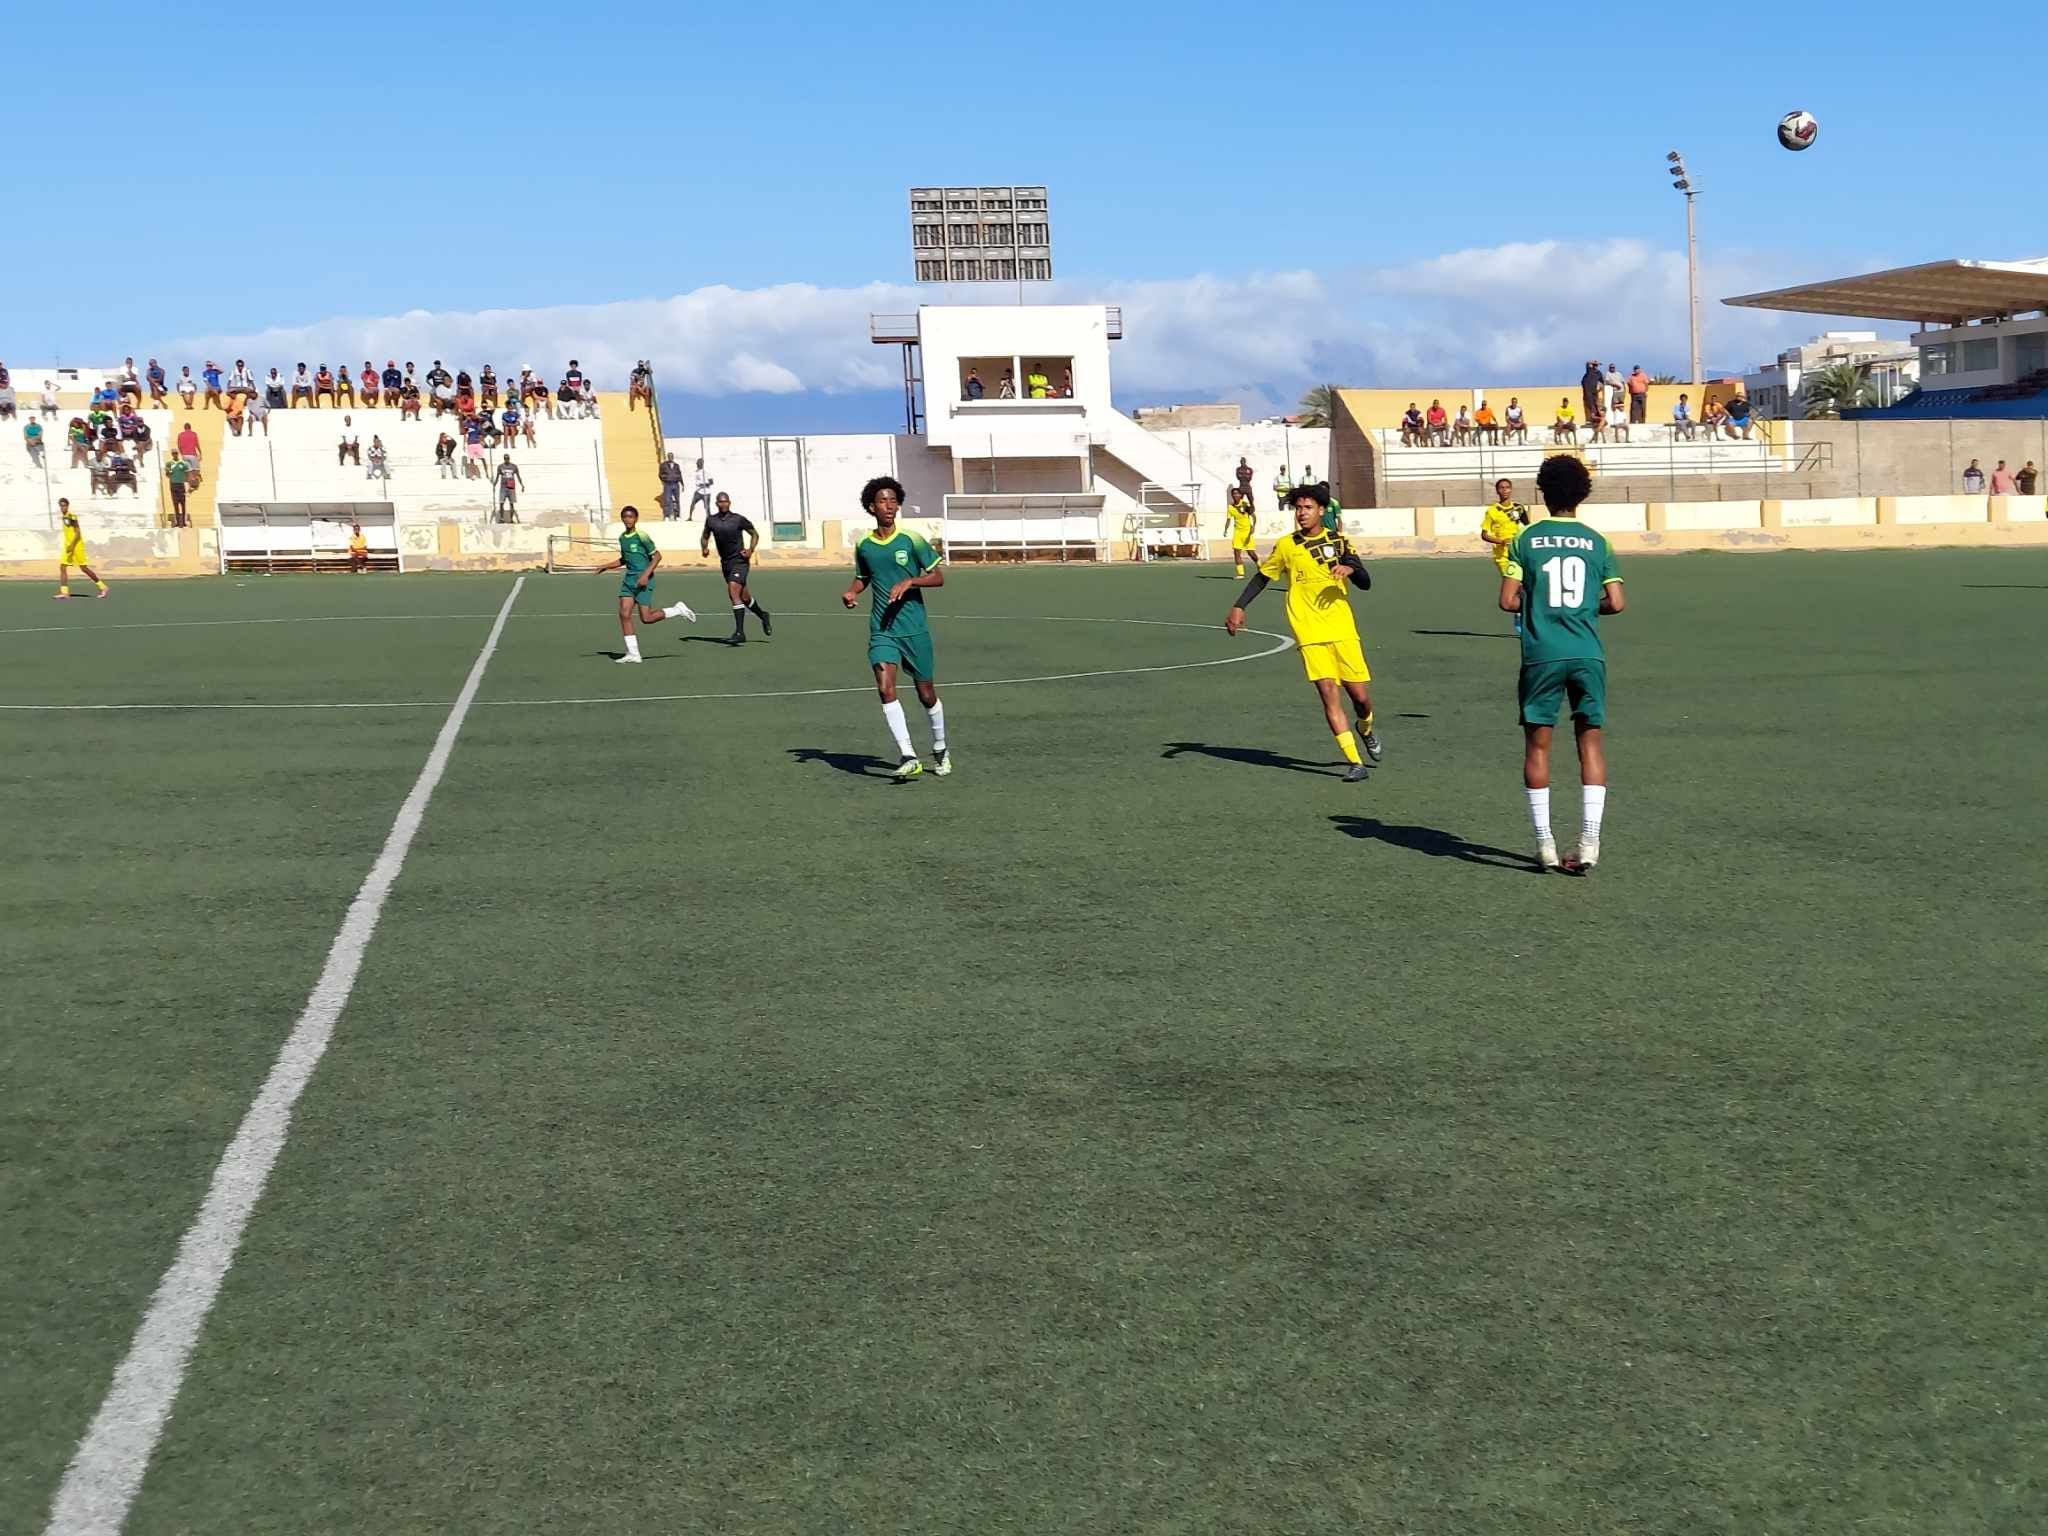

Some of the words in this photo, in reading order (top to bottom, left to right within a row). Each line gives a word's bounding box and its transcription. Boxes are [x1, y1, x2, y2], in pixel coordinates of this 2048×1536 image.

[1531, 536, 1593, 550] ELTON
[1506, 564, 1516, 576] C
[1542, 556, 1586, 608] 19
